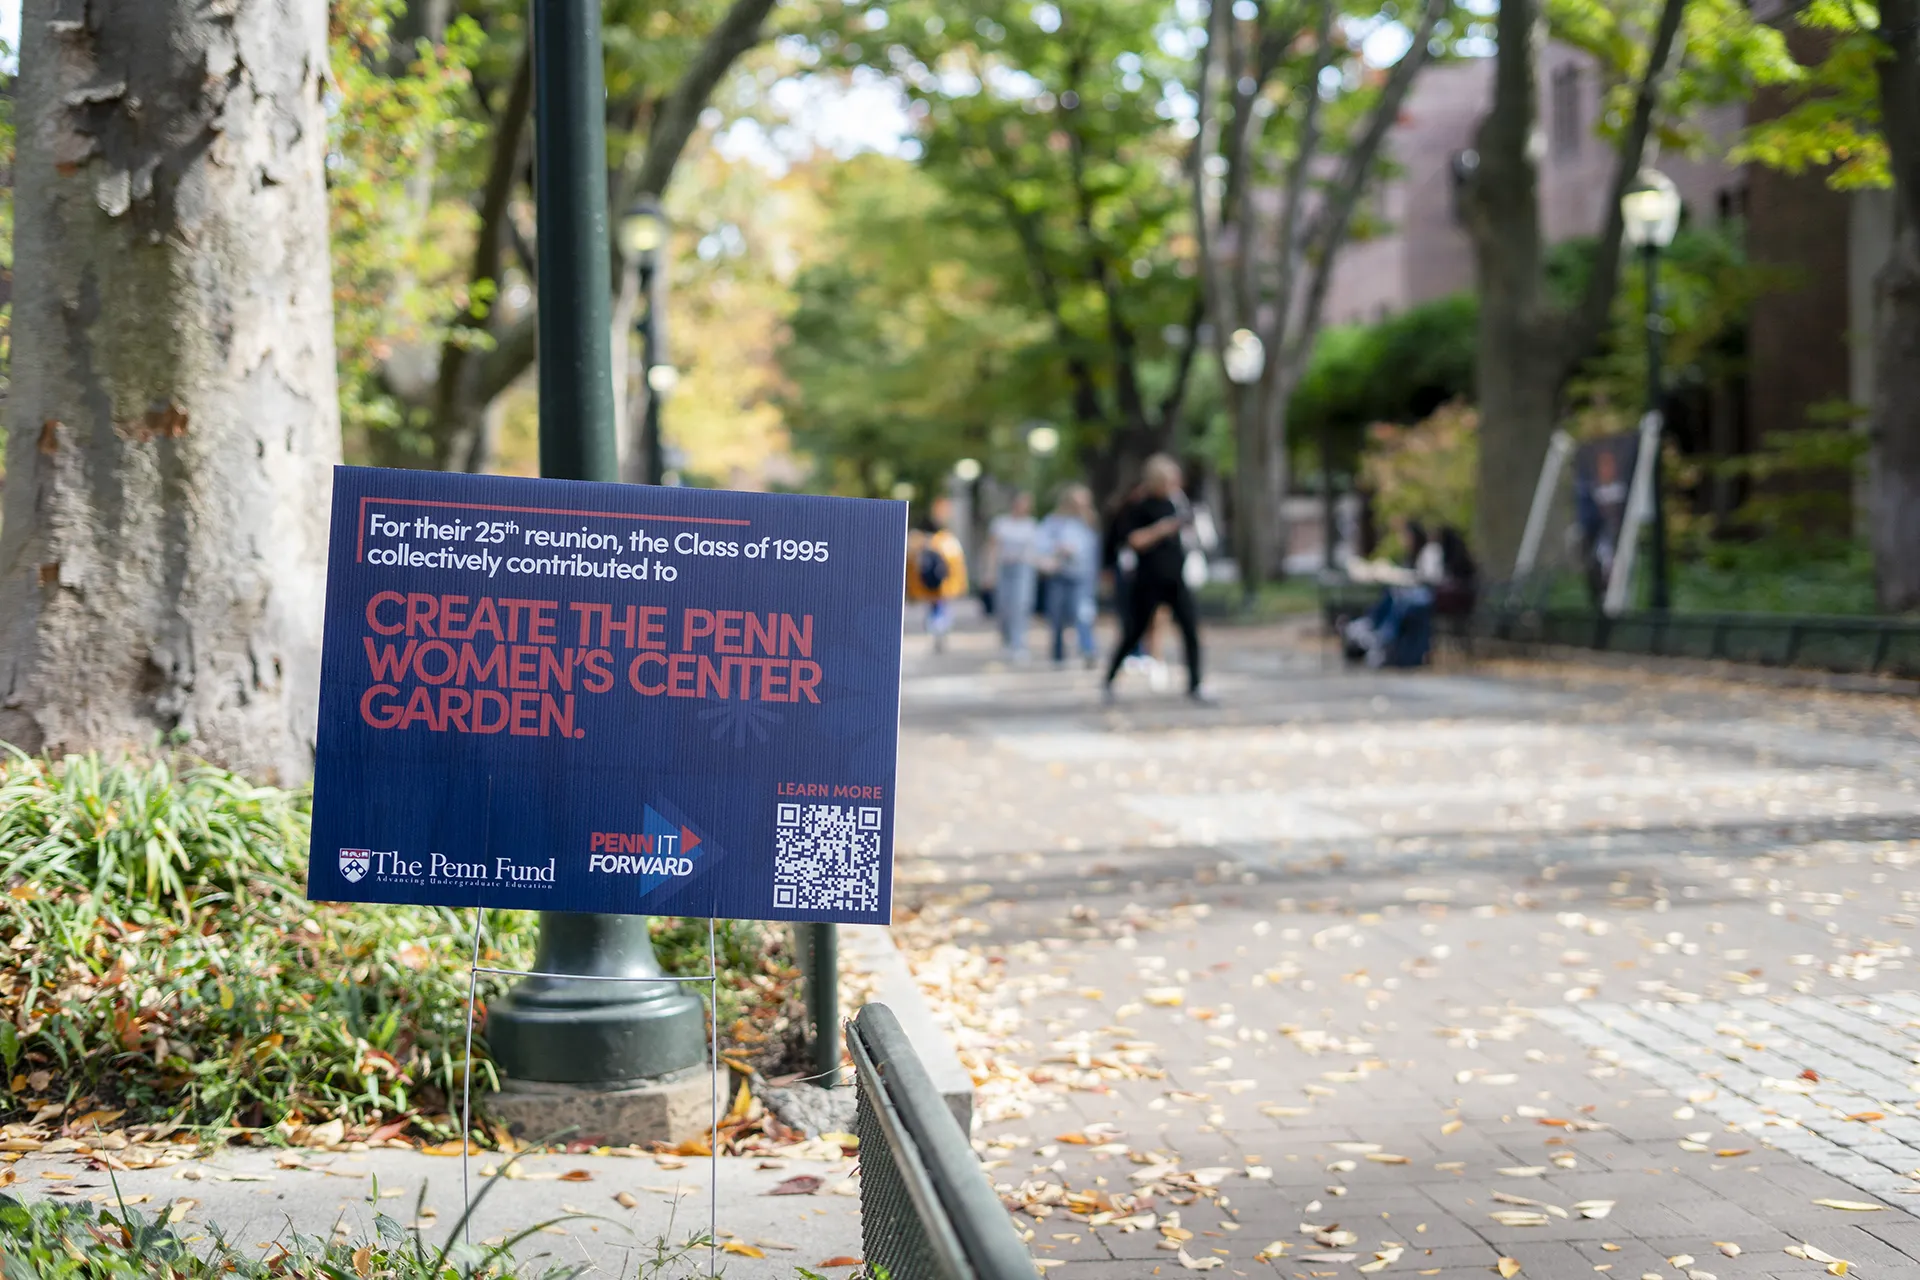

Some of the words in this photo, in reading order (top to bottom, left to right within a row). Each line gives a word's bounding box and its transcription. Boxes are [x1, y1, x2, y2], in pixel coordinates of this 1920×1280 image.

[371, 513, 410, 538] For
[414, 516, 471, 541] their
[475, 520, 519, 544] 25th
[525, 526, 623, 555] reunion,
[629, 529, 669, 553] the
[674, 532, 739, 557] Class
[744, 537, 770, 559] of
[773, 539, 829, 562] 1995
[367, 543, 502, 578] collectively
[506, 554, 648, 580] contributed
[653, 560, 678, 582] to
[365, 590, 558, 645] CREATE
[570, 602, 667, 650] THE
[683, 608, 814, 658] PENN
[363, 637, 614, 693] WOMEN’S
[628, 651, 823, 704] CENTER
[360, 683, 585, 739] GARDEN.
[777, 782, 829, 797] LEARN
[833, 785, 883, 800] MORE
[590, 832, 653, 854] PENN
[657, 835, 678, 854] IT
[372, 851, 423, 876] The
[429, 852, 488, 879] Penn
[495, 857, 556, 882] Fund
[376, 875, 425, 886] Advancing
[429, 877, 501, 888] Undergraduate
[505, 880, 553, 890] Education
[589, 854, 694, 876] FORWARD
